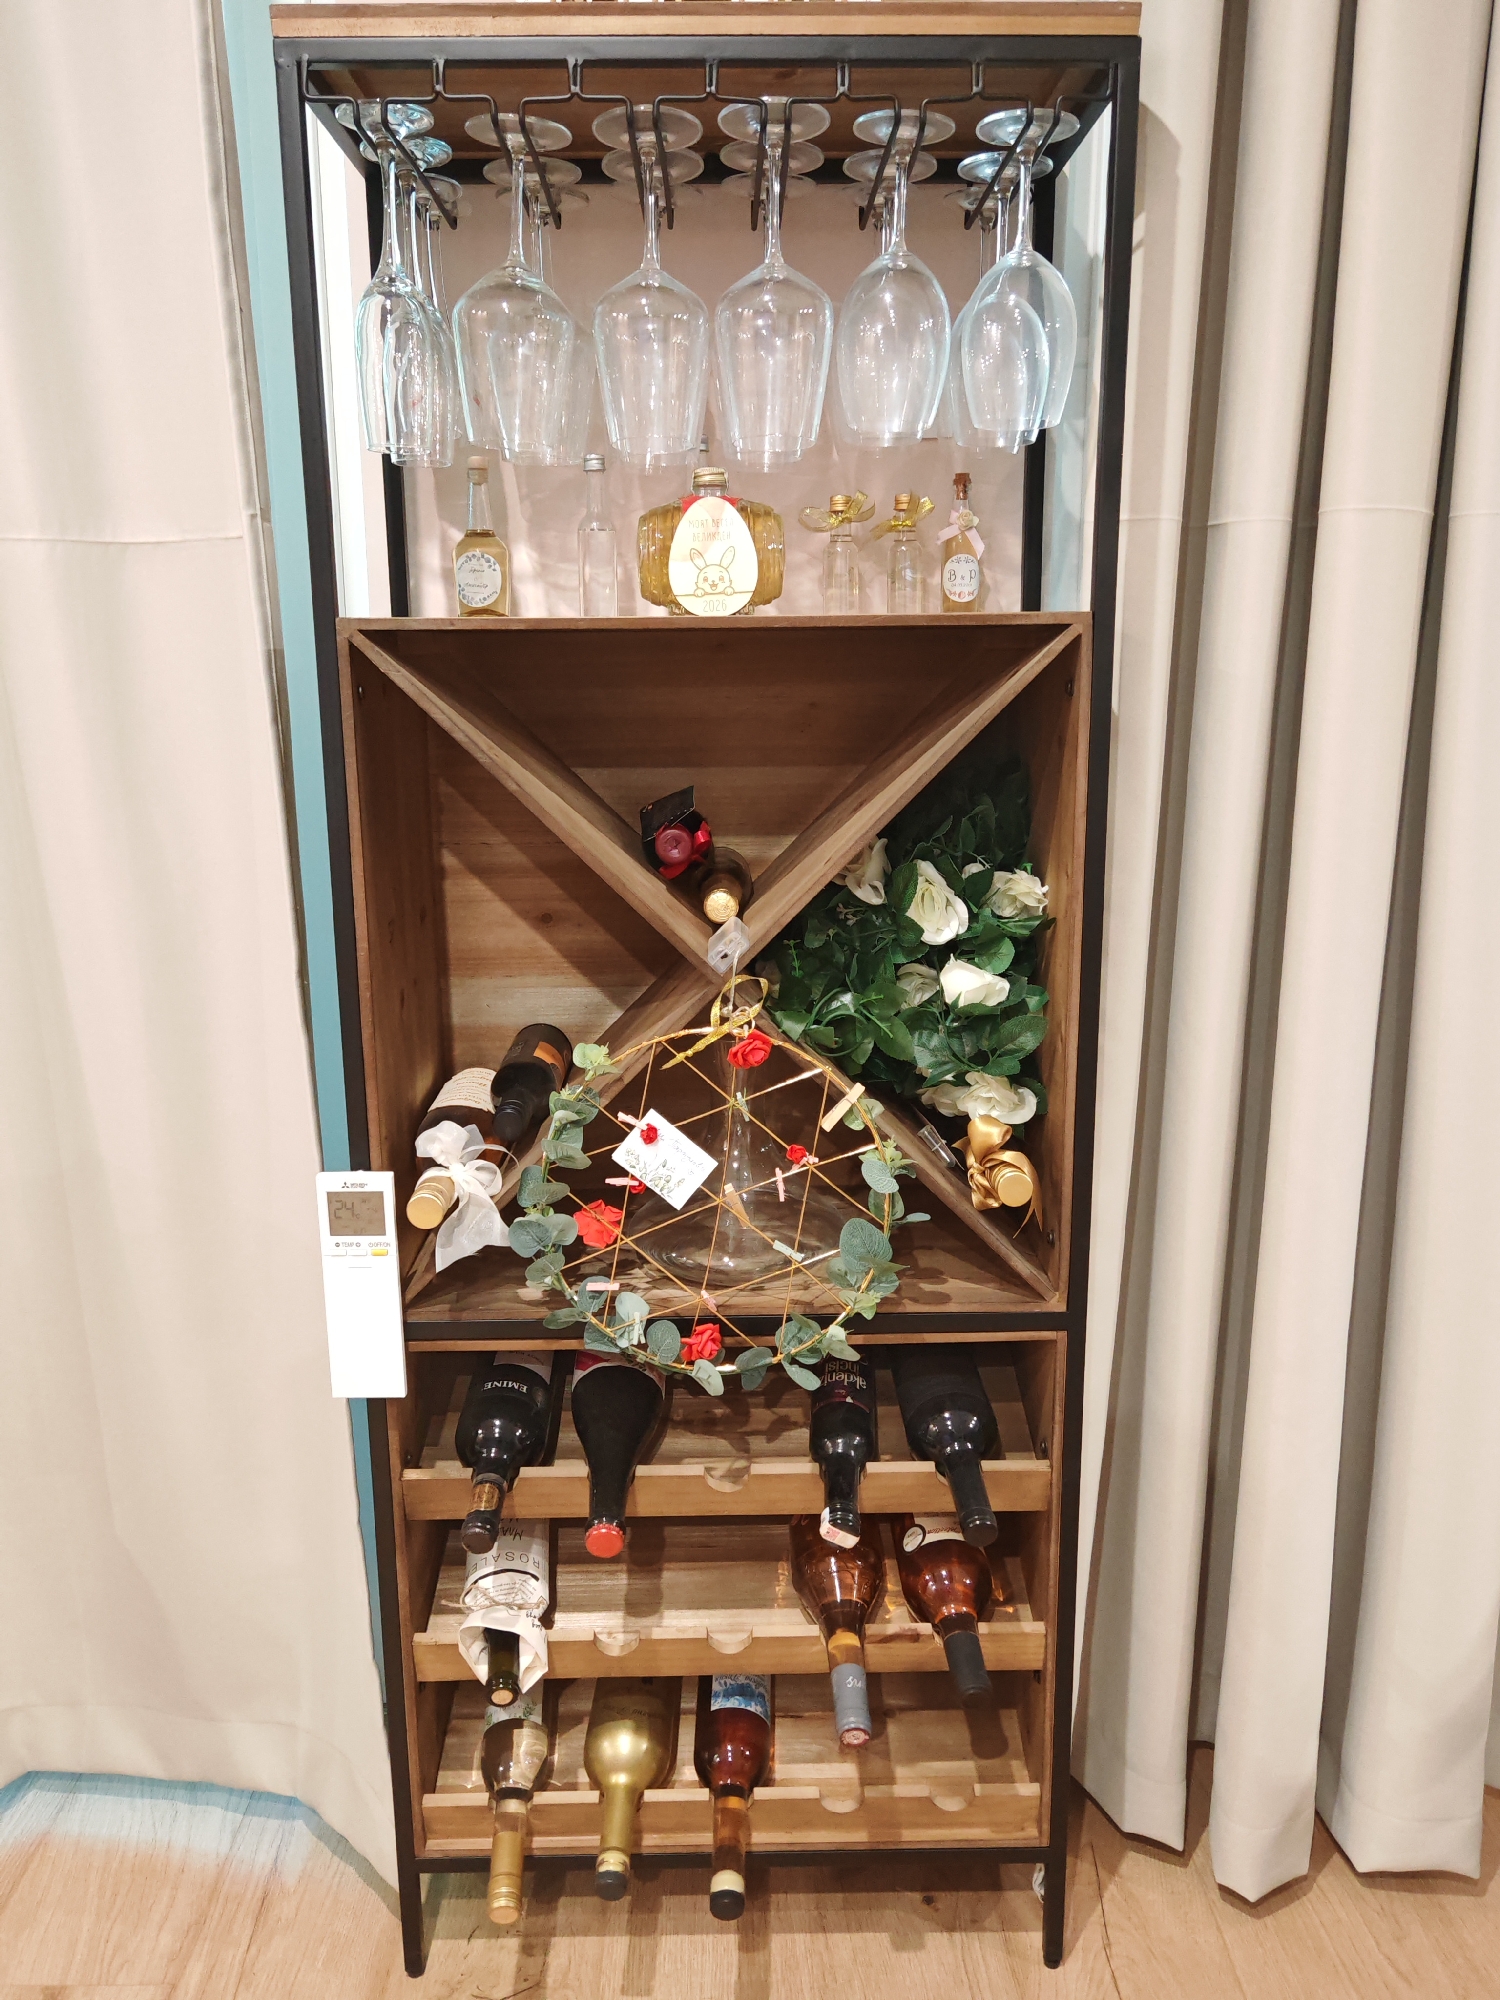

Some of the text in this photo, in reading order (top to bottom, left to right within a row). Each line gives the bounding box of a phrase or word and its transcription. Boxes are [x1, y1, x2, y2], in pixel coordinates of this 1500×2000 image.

[692, 532, 731, 543] ВЕЛИКДЕН
[948, 569, 956, 582] B
[968, 569, 976, 583] P
[702, 599, 728, 613] 2026
[334, 1200, 354, 1219] 24
[483, 1380, 528, 1394] EMINE
